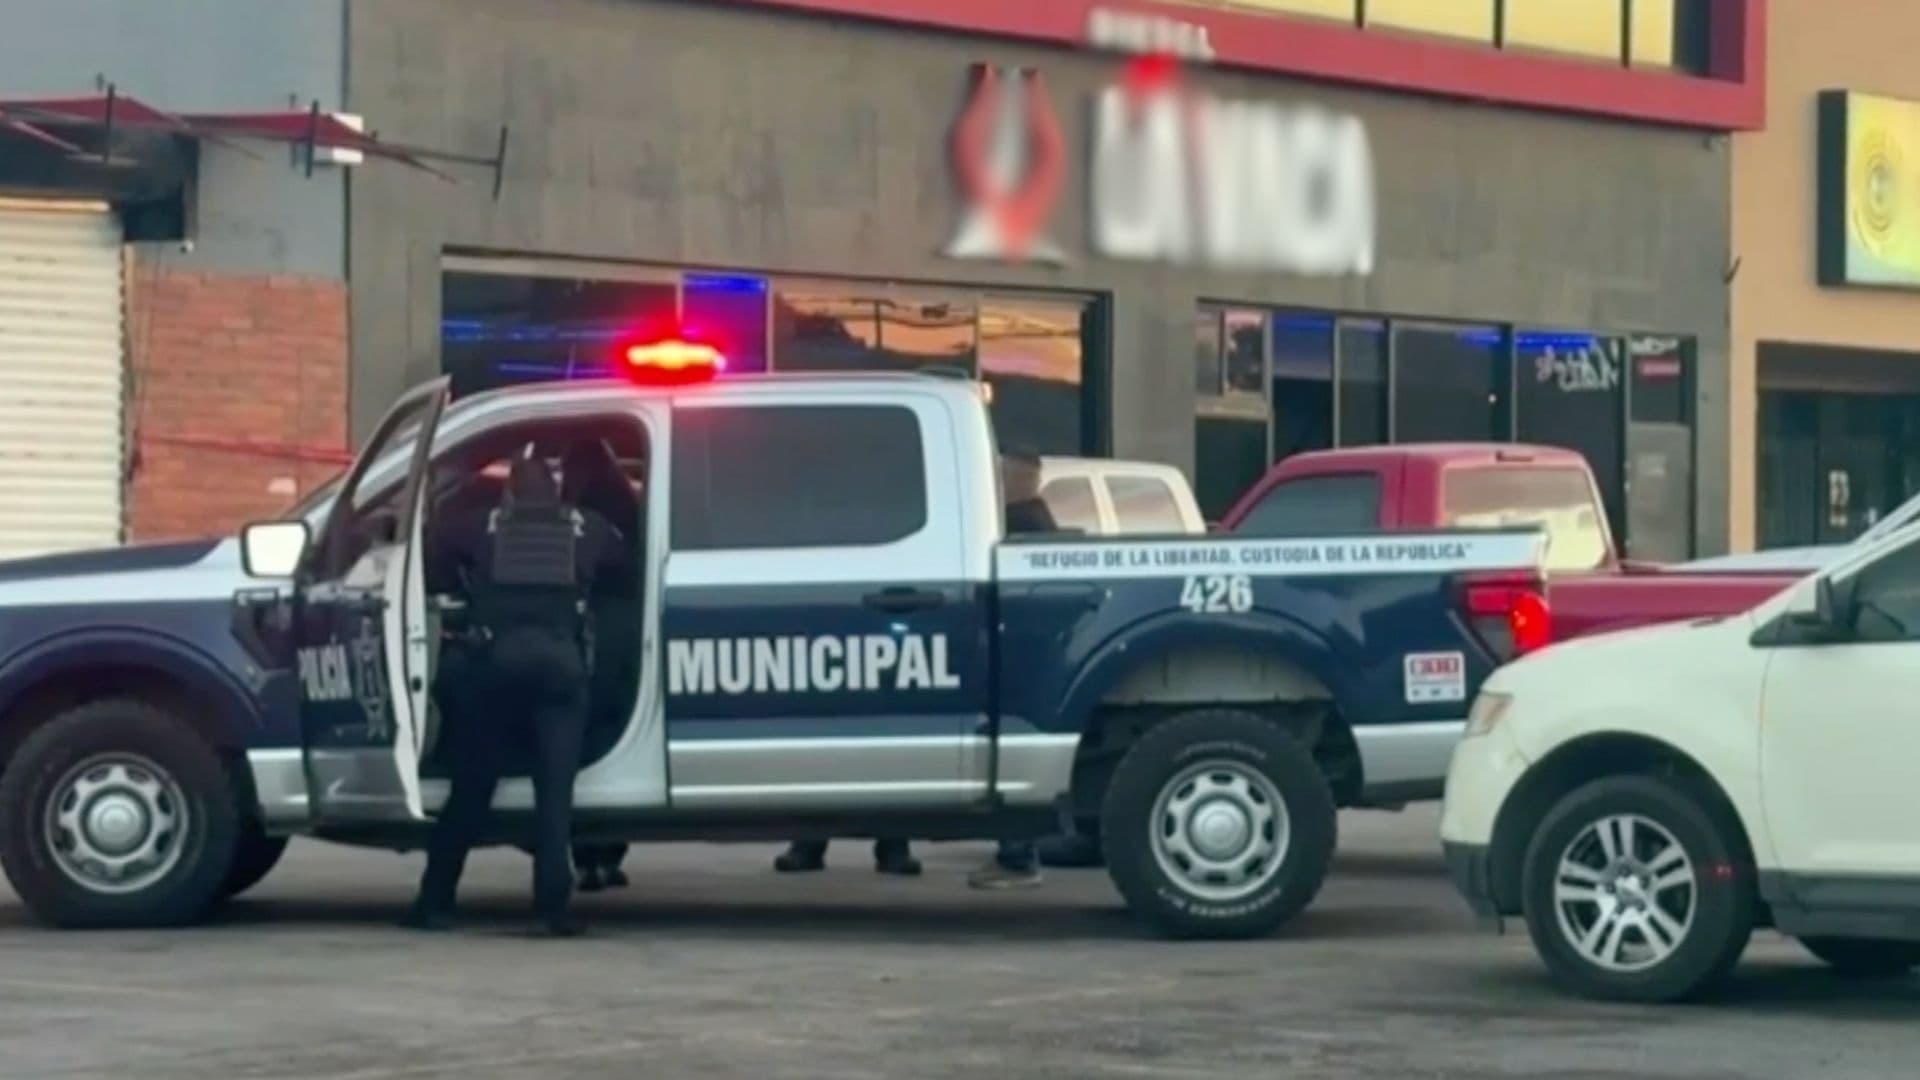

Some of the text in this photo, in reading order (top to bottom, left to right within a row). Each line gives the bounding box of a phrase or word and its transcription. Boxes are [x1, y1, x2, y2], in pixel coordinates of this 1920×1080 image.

[1104, 549, 1122, 567] DE
[1129, 549, 1150, 566] LA
[1240, 546, 1320, 563] CUSTODIA
[1325, 545, 1344, 562] DE
[1350, 544, 1371, 561] LA
[1180, 575, 1254, 613] 426
[667, 633, 960, 694] MUNICIPAL
